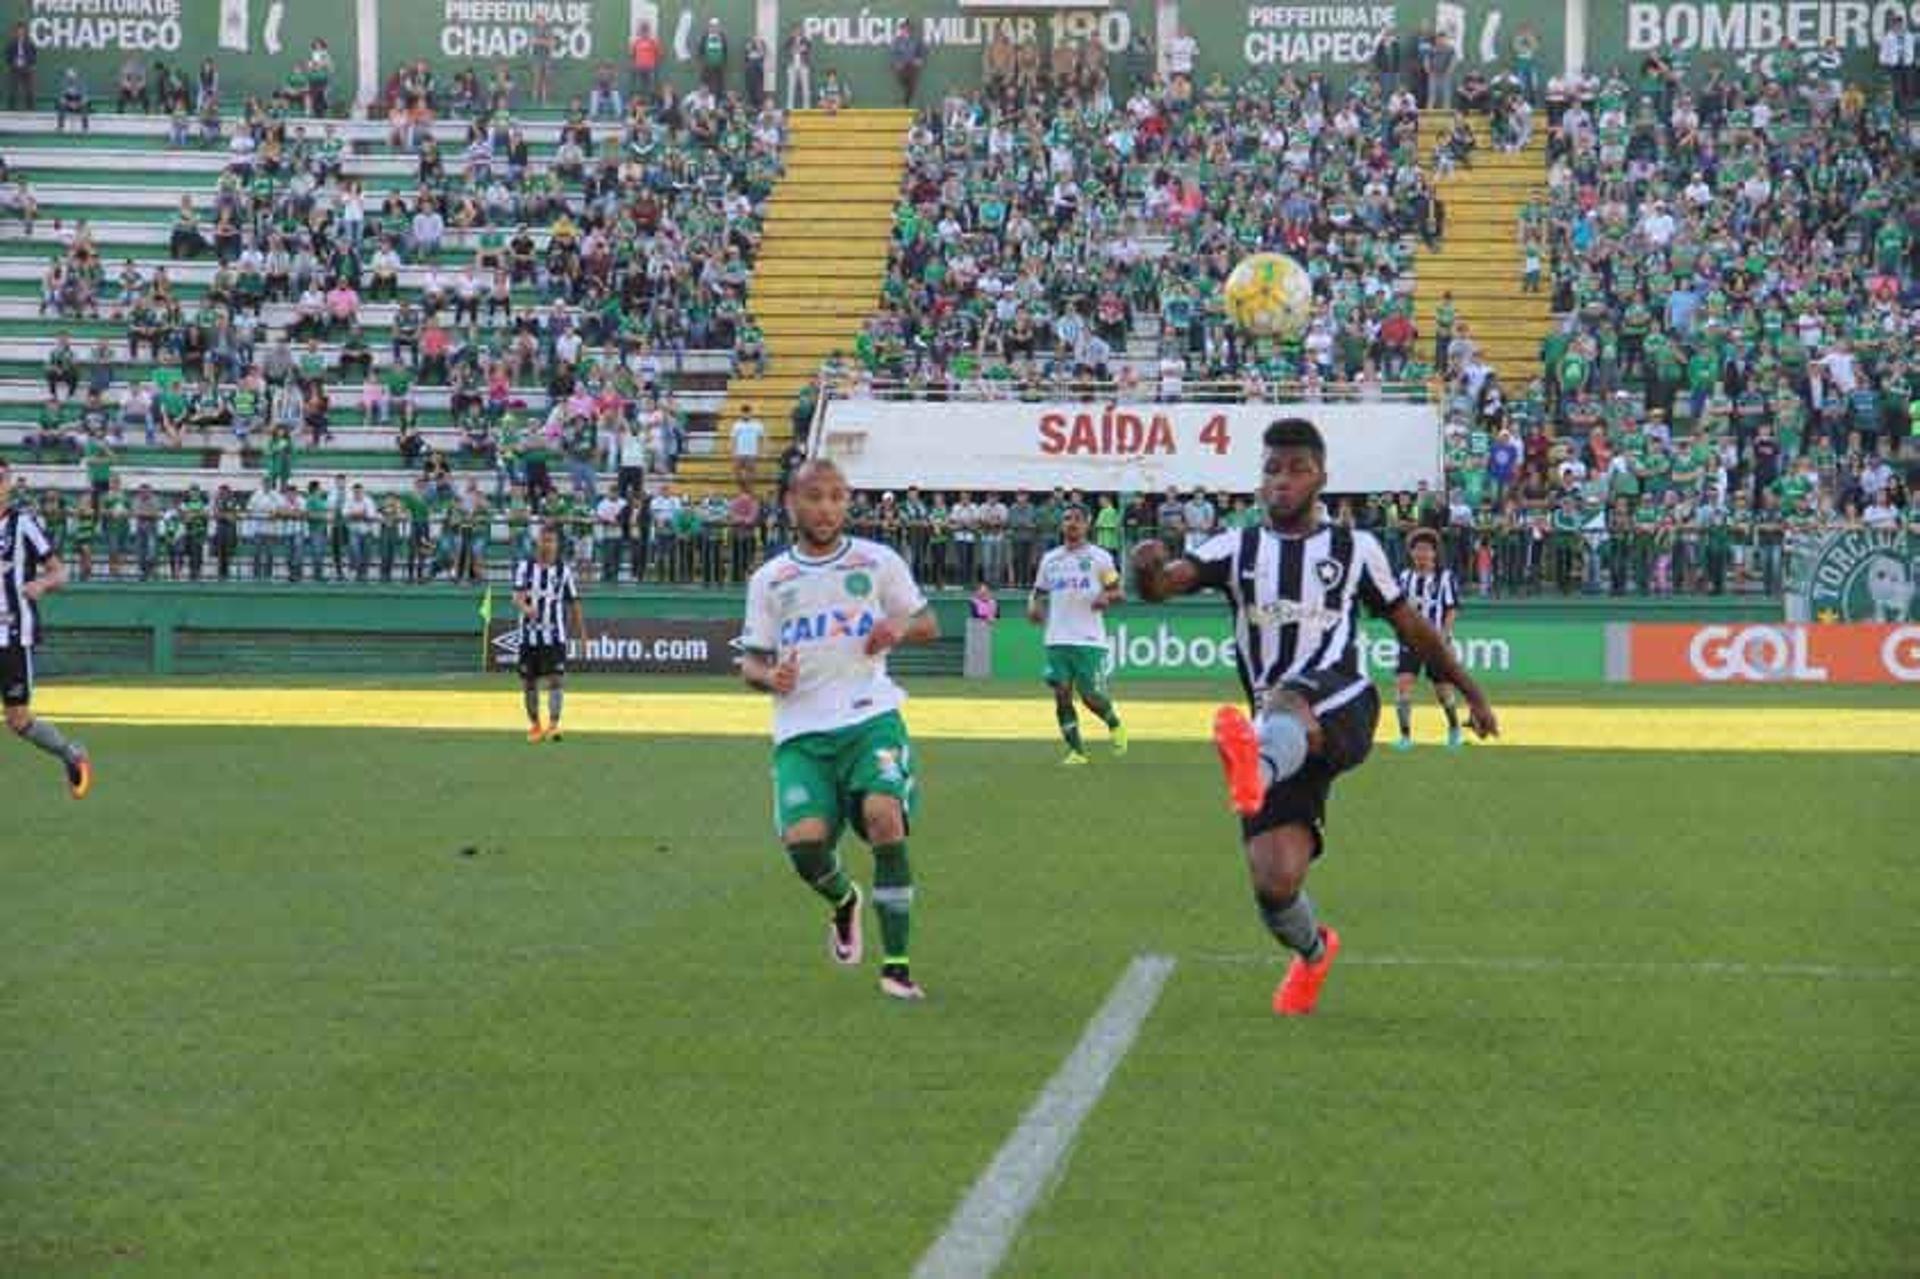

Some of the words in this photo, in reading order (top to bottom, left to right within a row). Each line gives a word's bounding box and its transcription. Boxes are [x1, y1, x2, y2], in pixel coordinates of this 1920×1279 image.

[156, 0, 182, 16] DE
[445, 0, 564, 22] PREFEITURA
[567, 1, 593, 25] DE
[1248, 6, 1369, 27] PREFEITURA
[1371, 6, 1396, 29] DE
[29, 16, 182, 49] CHAPECÓ
[440, 24, 592, 58] CHAPCÓ
[923, 17, 1038, 45] MILITAR
[1049, 10, 1130, 52] 190
[1039, 406, 1176, 455] SAÍDA
[1199, 414, 1230, 455] 4
[781, 608, 874, 647] CAIXA
[1689, 625, 1828, 681] GOL
